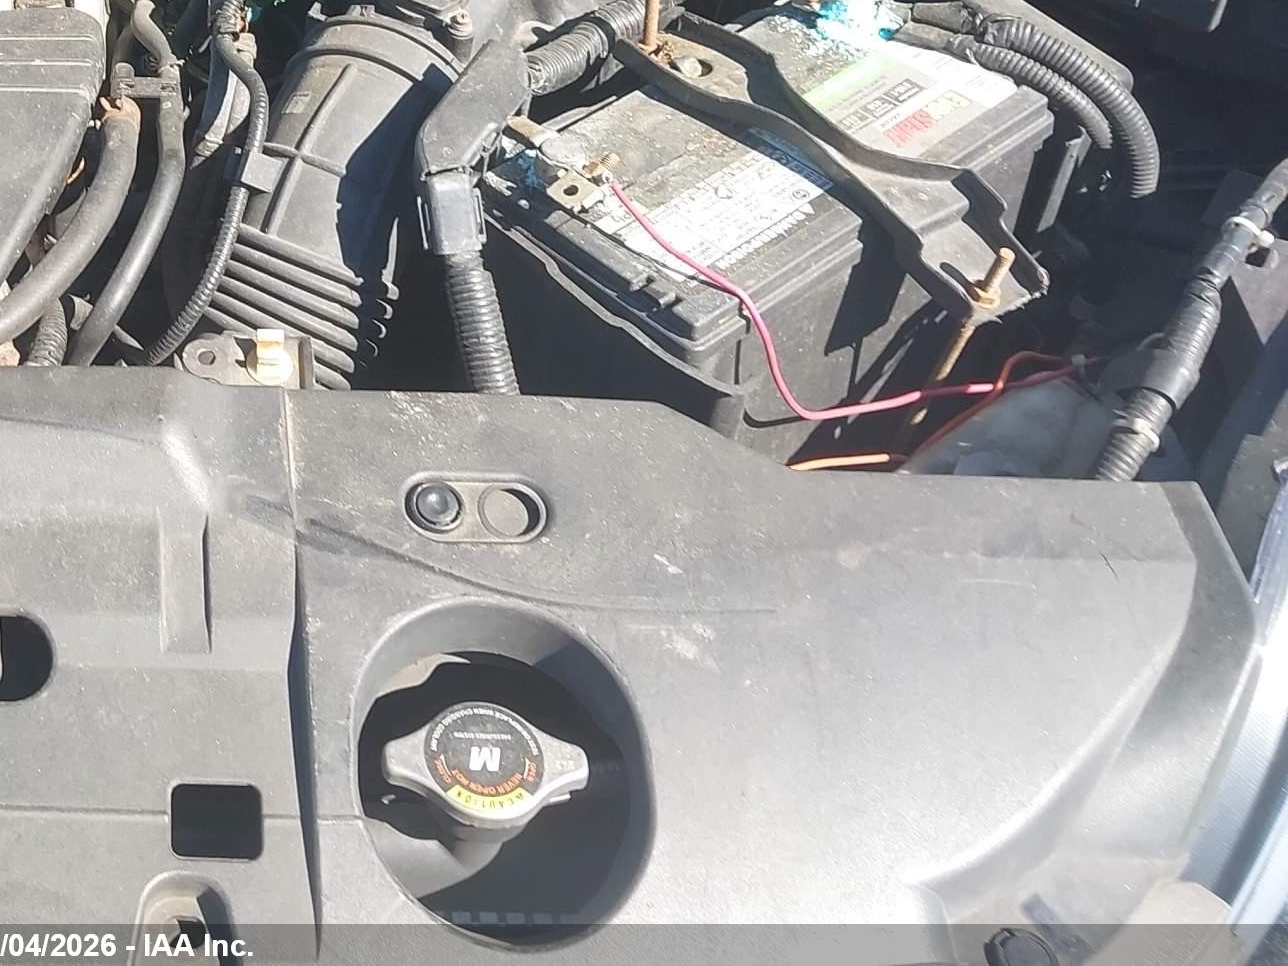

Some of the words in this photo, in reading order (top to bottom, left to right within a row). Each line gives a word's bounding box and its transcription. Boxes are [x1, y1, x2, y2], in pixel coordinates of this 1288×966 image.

[450, 769, 471, 786] HOT
[496, 771, 523, 792] NEVER
[468, 781, 497, 795] OPEN
